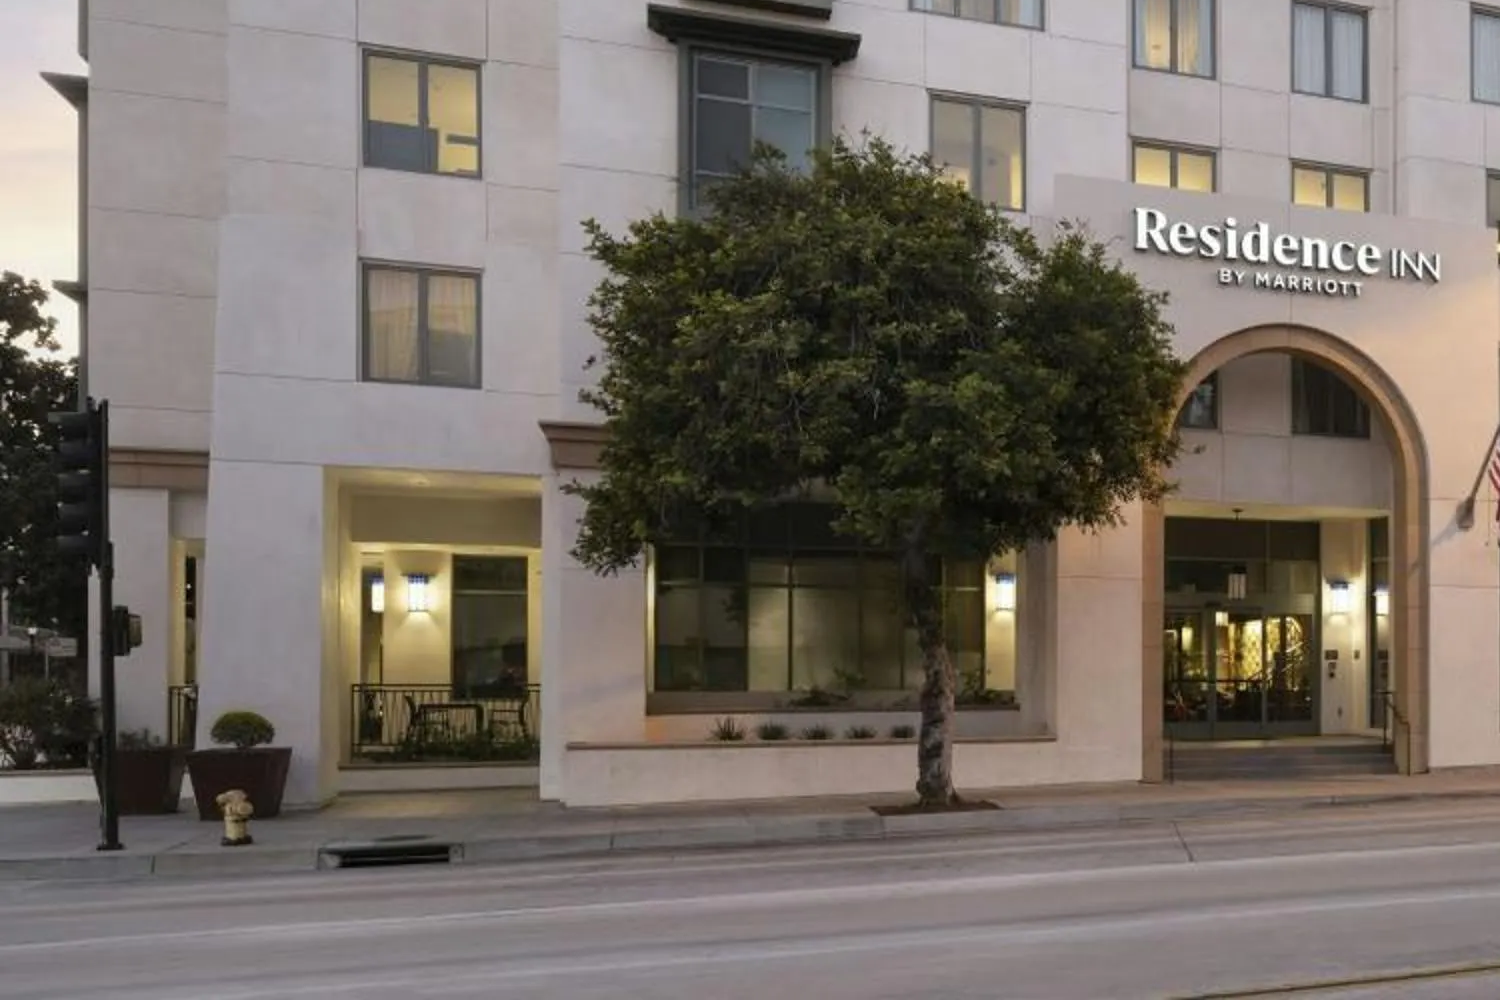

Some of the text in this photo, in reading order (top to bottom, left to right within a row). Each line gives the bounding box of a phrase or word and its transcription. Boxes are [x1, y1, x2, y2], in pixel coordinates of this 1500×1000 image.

[1134, 207, 1442, 283] Residence INN
[1217, 267, 1365, 298] BY MARRIOTT
